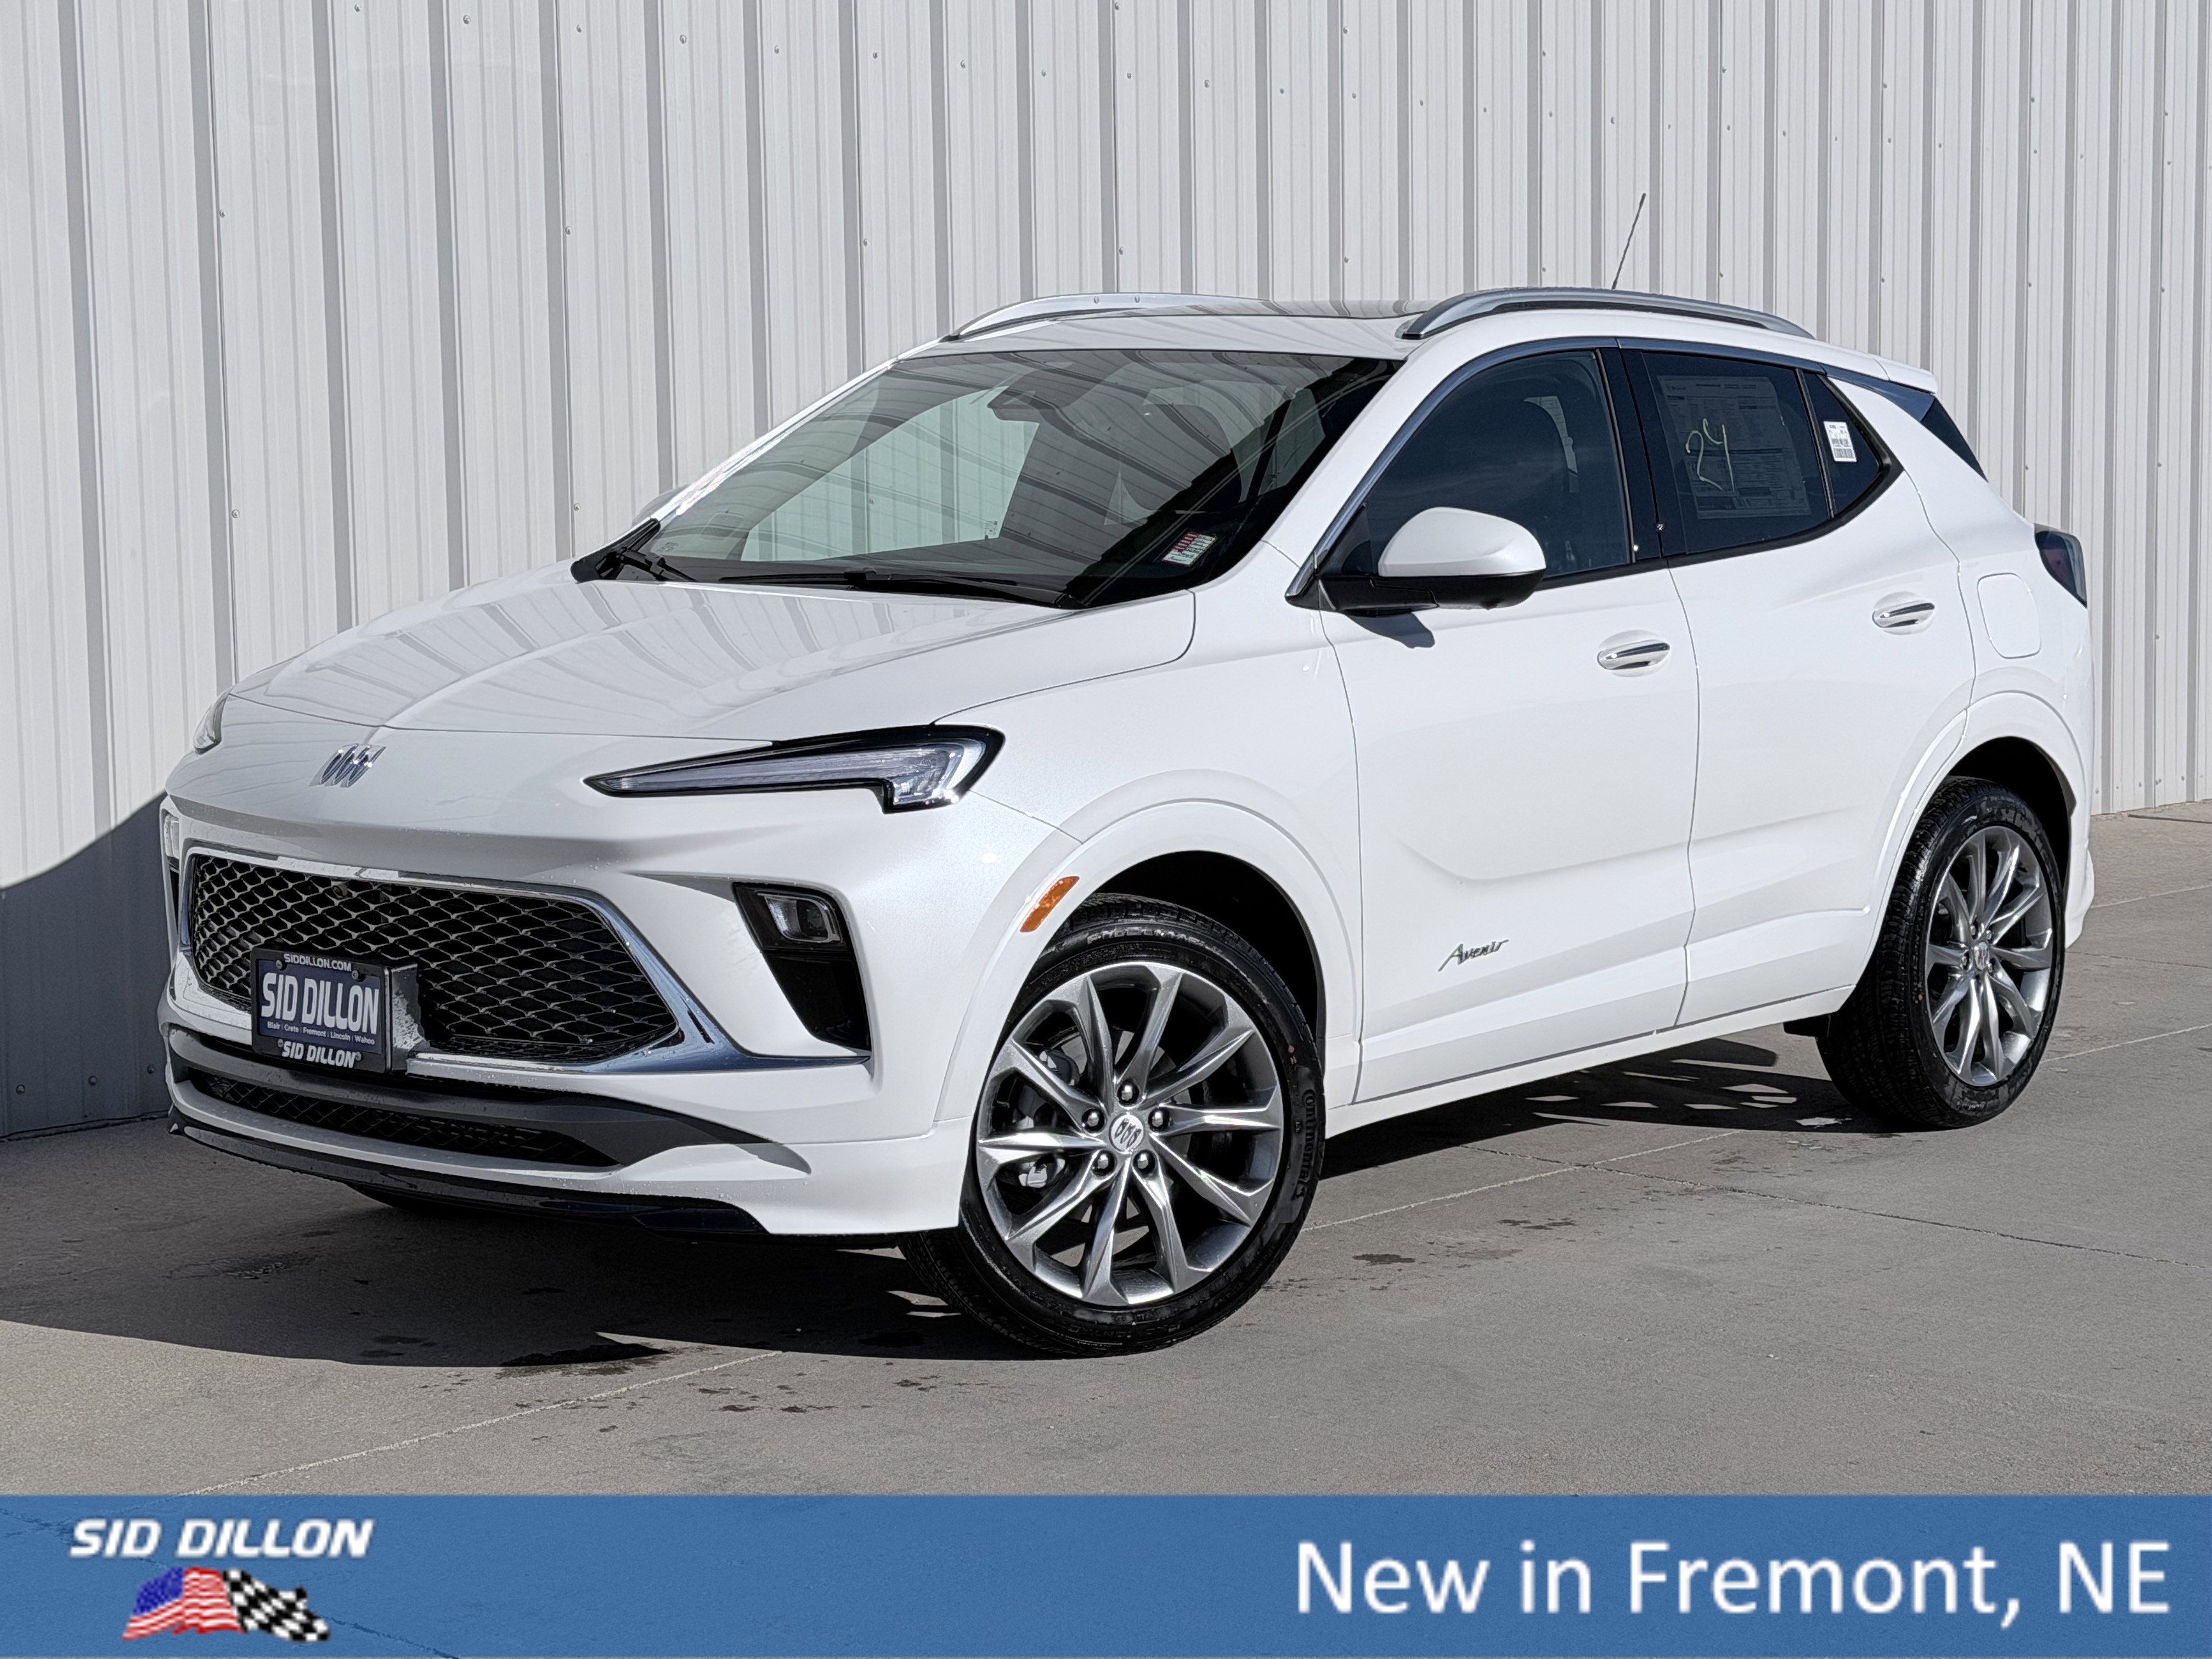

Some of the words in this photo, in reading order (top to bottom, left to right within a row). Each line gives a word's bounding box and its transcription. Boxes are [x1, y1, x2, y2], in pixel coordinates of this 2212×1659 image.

[1685, 417, 1735, 492] 24
[284, 953, 352, 972] SIDDILLON.COM
[261, 972, 298, 1022] SID
[301, 978, 379, 1035] DILLON
[284, 1024, 300, 1033] Crete
[303, 1027, 326, 1038] Fremont
[330, 1031, 351, 1041] Lincoln
[354, 1035, 375, 1045] Wahoo
[281, 1041, 304, 1060] SID
[306, 1045, 357, 1069] DILLON
